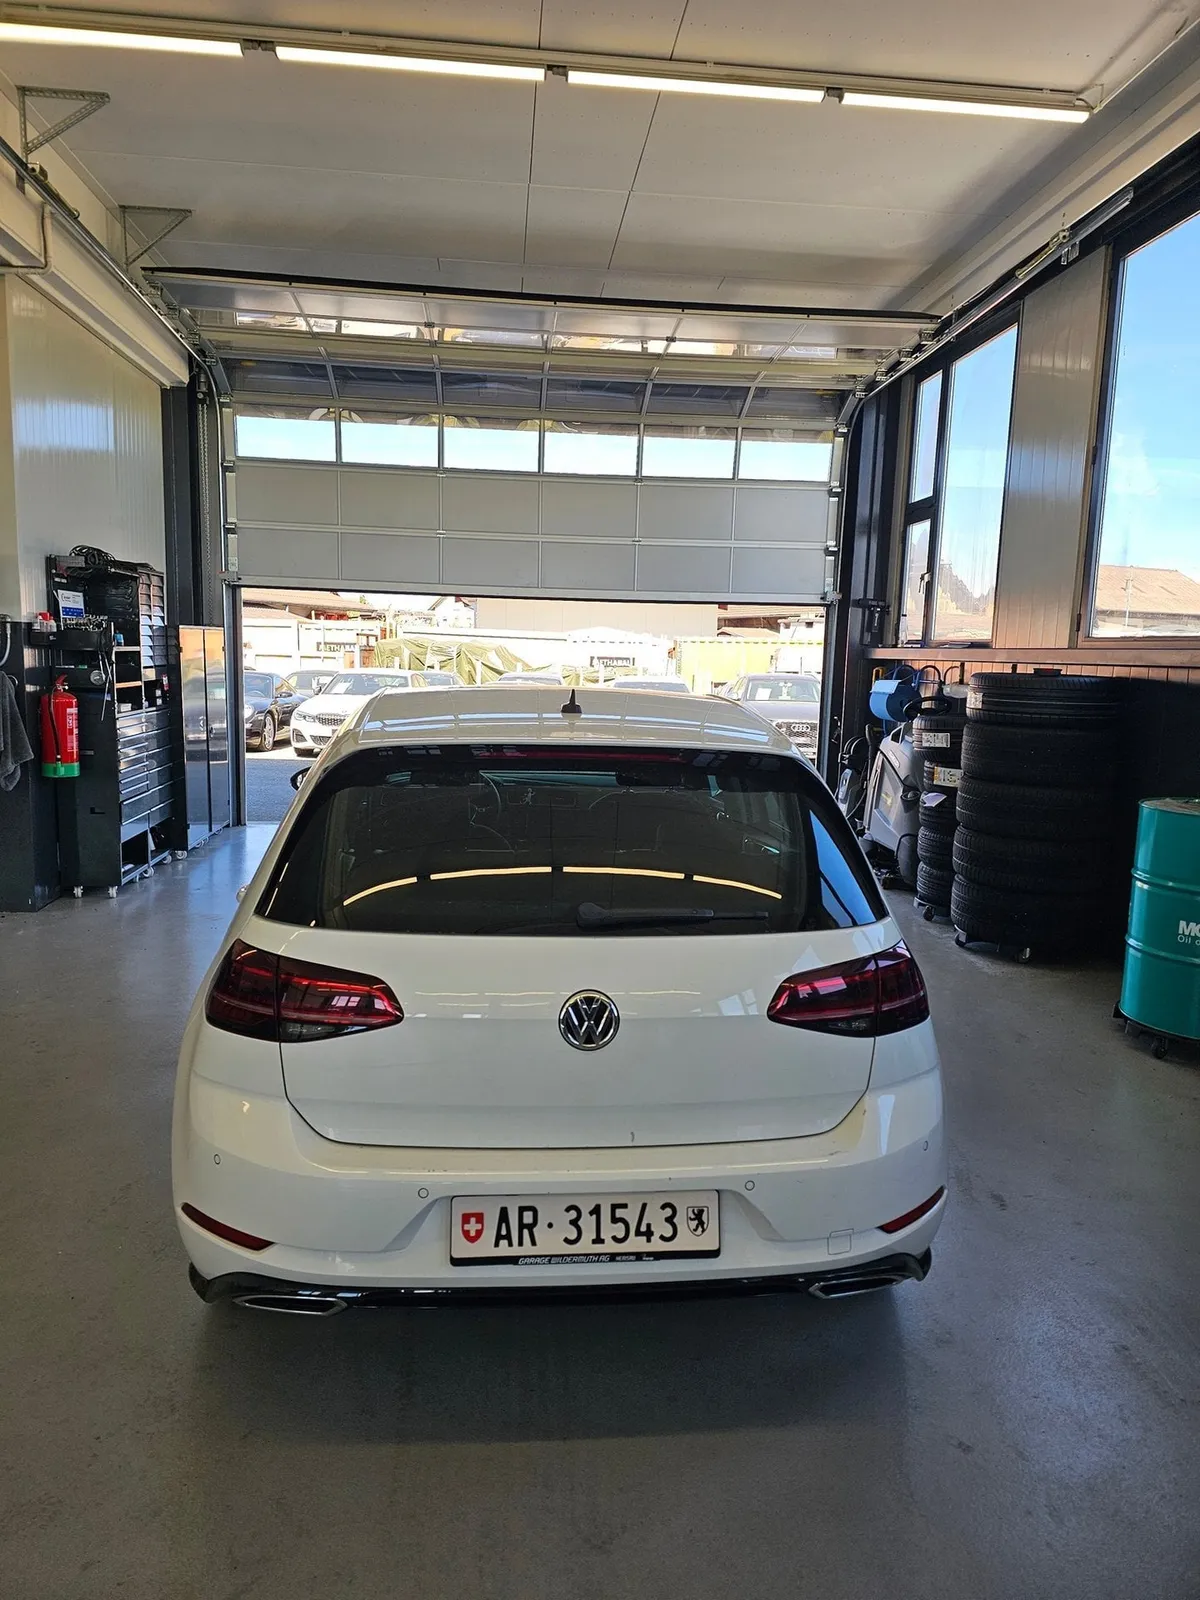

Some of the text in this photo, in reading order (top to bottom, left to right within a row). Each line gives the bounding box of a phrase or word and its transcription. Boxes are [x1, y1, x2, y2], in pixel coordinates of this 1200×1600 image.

[1177, 934, 1191, 944] Oil
[560, 991, 618, 1049] VW
[518, 1256, 551, 1265] GARAGE
[599, 1254, 610, 1262] AG
